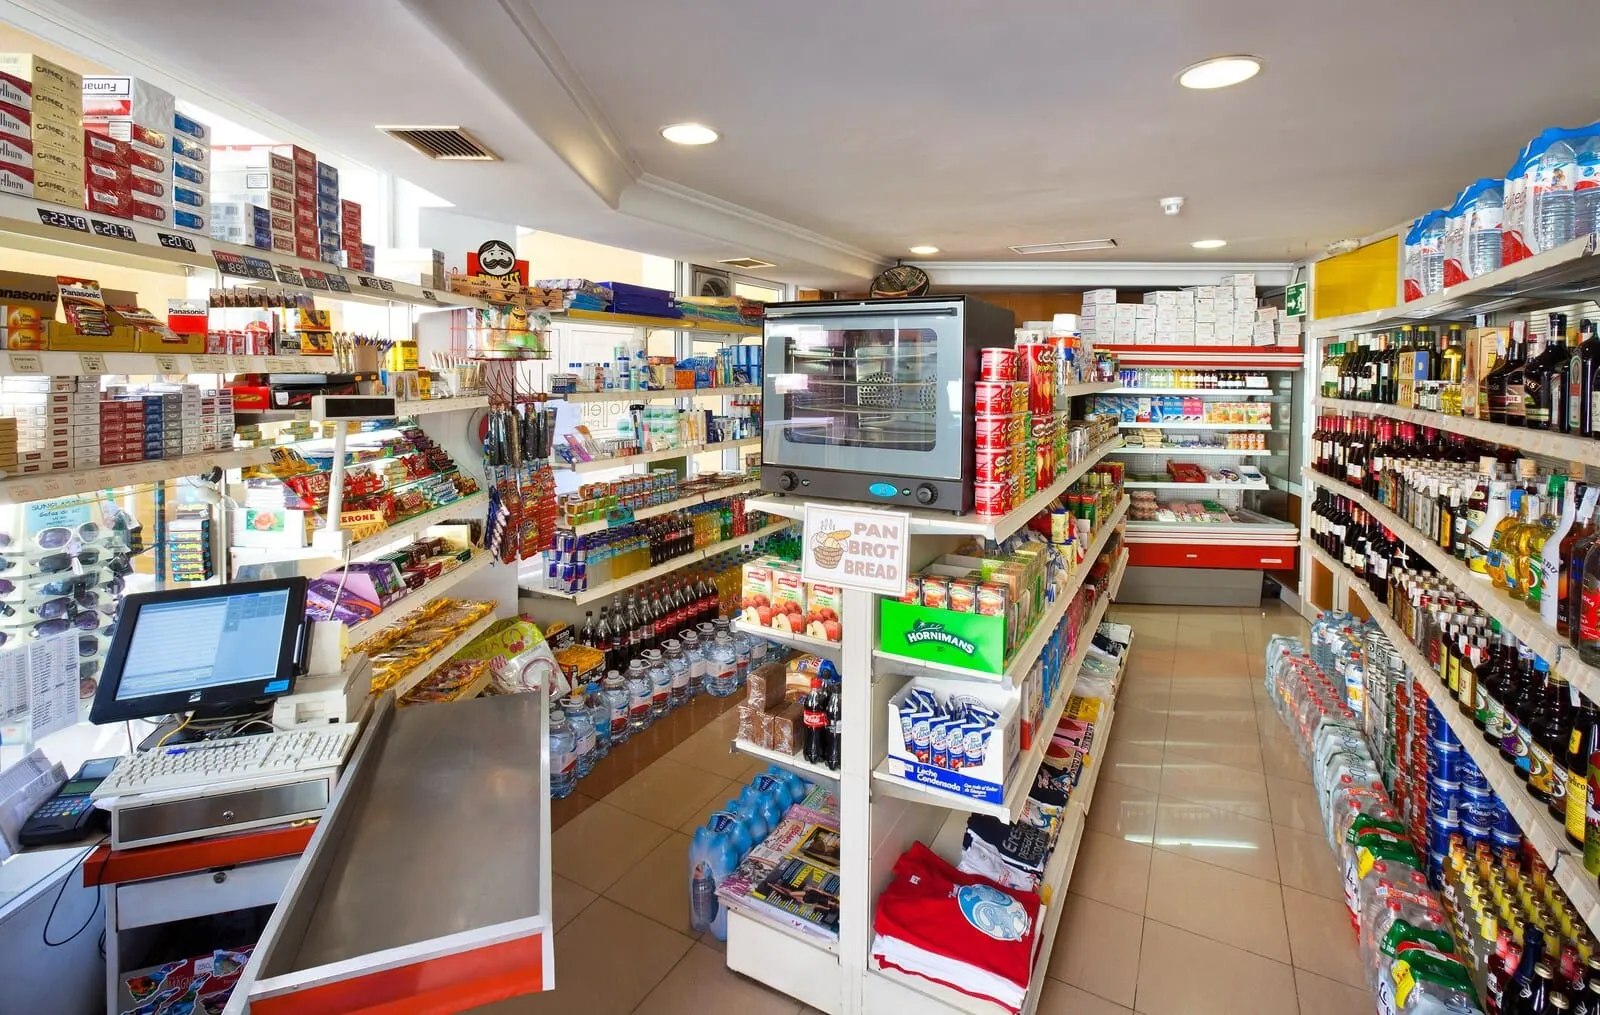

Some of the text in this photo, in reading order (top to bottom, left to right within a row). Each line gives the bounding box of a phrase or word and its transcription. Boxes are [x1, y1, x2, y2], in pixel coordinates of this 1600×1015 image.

[0, 84, 22, 103] rlboro
[0, 143, 23, 161] rlboro
[0, 173, 24, 191] rlboro
[0, 288, 57, 303] anasonic
[61, 287, 101, 299] Panasonic
[168, 308, 205, 316] Panasonic
[341, 513, 376, 523] ERONE
[853, 521, 900, 540] PAN
[848, 540, 900, 560] BROT
[843, 561, 898, 581] BREAD
[907, 631, 976, 655] HORNIMANS
[917, 766, 938, 778] Leche
[917, 774, 961, 791] Condensada
